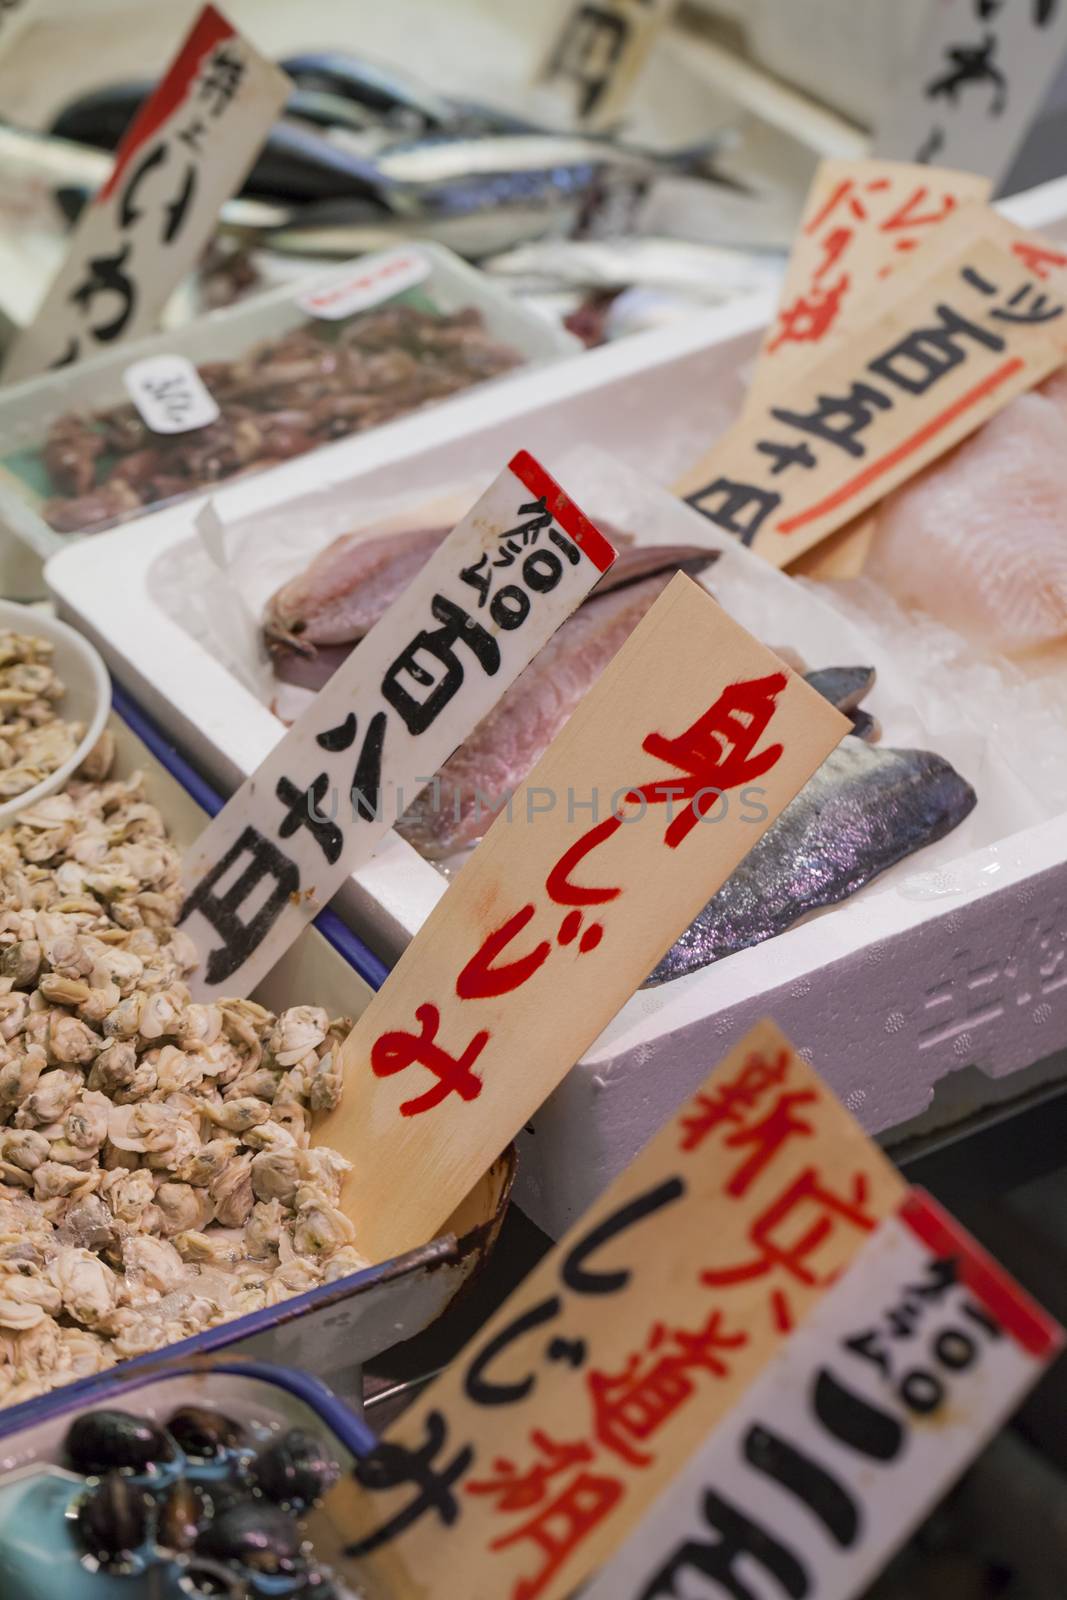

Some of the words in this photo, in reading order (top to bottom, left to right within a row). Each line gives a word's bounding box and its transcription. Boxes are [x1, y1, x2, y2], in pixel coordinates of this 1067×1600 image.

[177, 593, 501, 986] 百八十円
[371, 672, 789, 1118] 身しじみ
